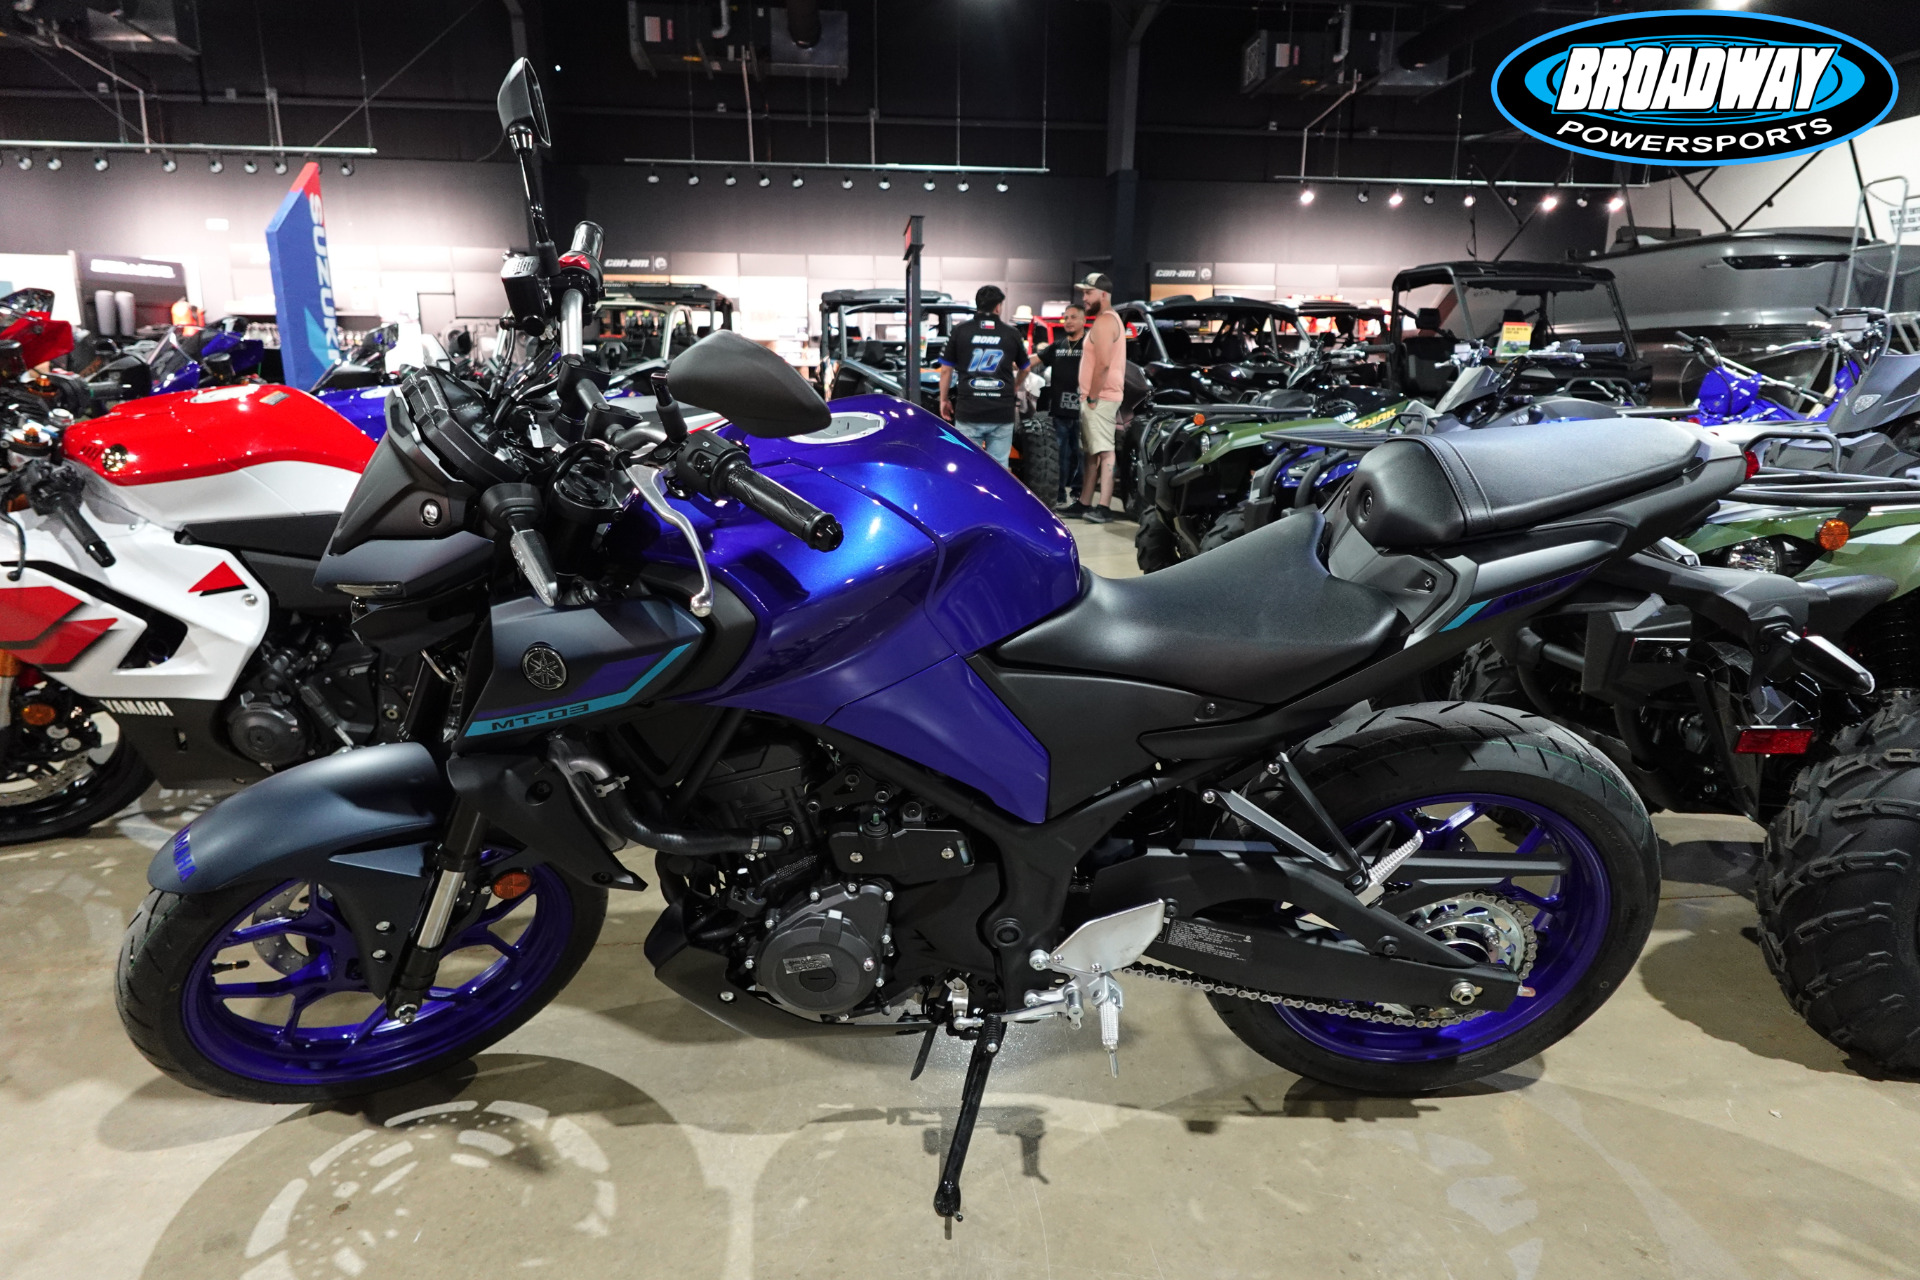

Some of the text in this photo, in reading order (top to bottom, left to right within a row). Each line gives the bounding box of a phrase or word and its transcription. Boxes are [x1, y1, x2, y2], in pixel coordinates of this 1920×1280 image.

[309, 192, 340, 360] SUZUKI
[968, 348, 1004, 372] 10
[99, 699, 174, 717] YAMAHA
[491, 703, 589, 731] MT-03
